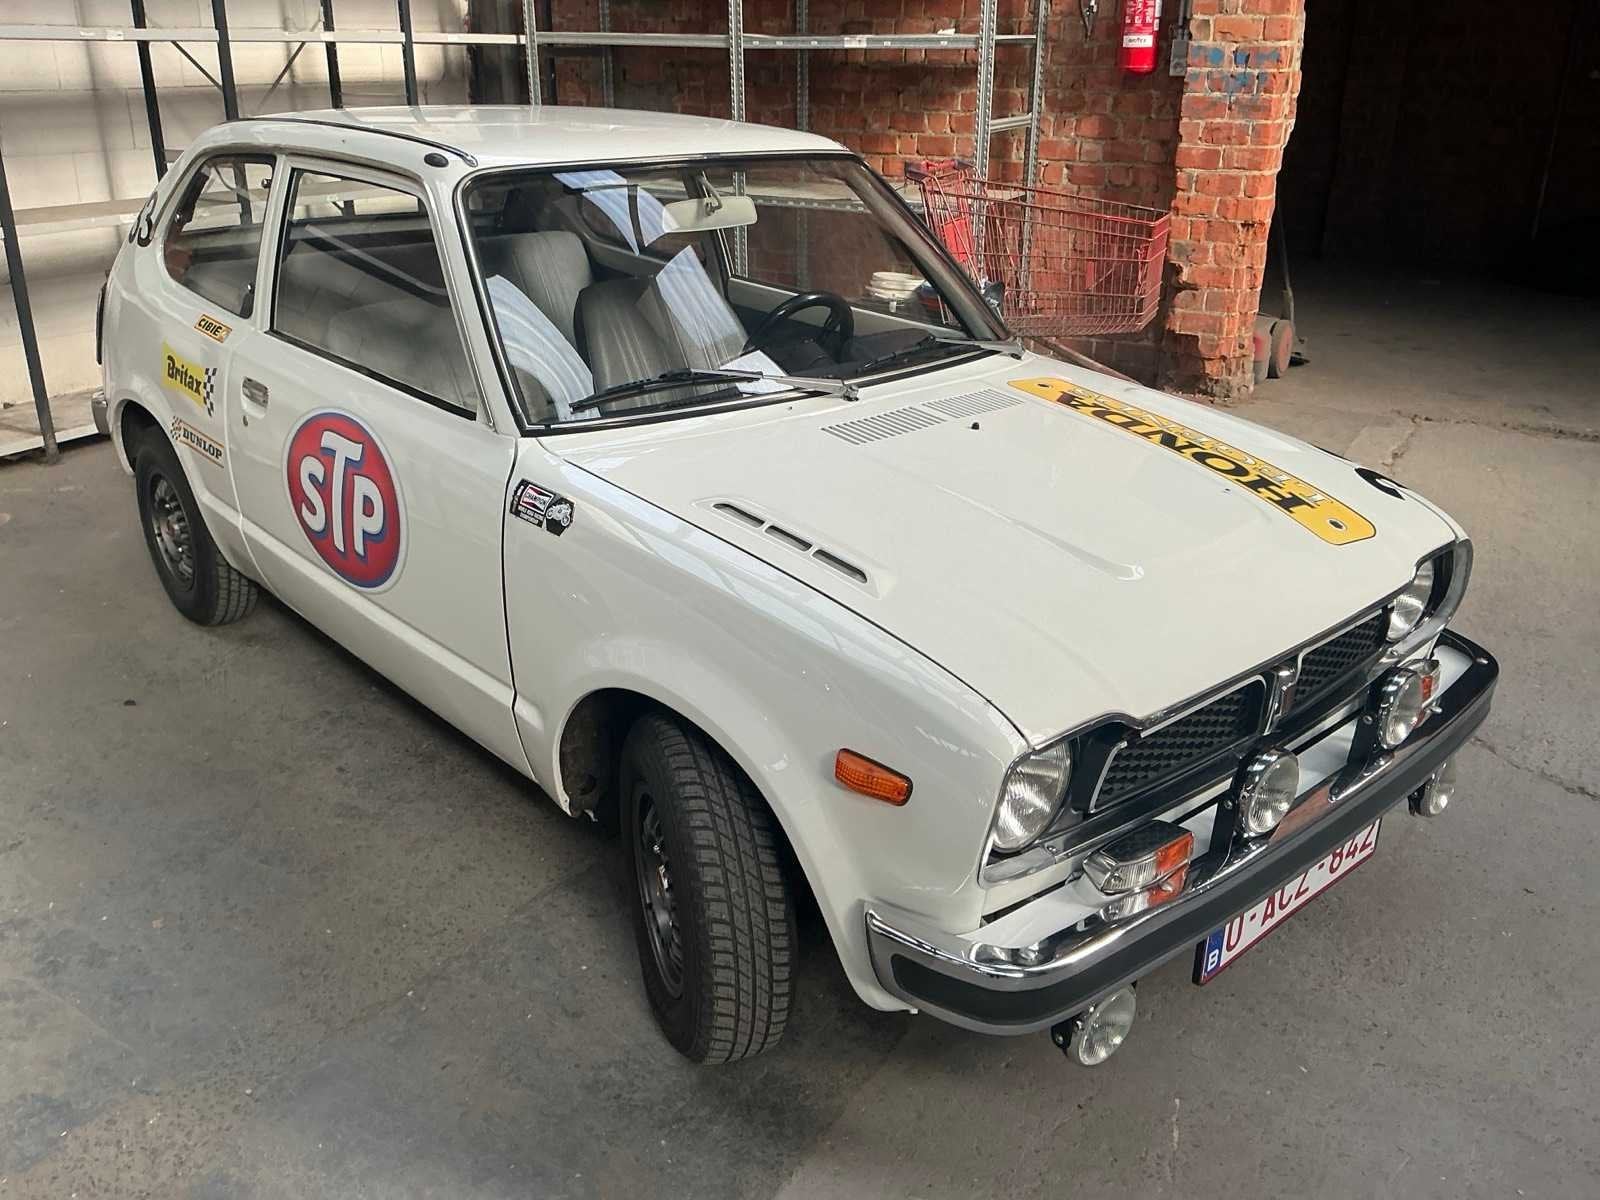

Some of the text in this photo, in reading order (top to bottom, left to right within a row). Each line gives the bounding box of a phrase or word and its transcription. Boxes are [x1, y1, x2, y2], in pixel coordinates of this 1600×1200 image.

[167, 355, 202, 396] Britax
[182, 427, 223, 460] DUNLOP
[1057, 391, 1316, 514] HONDA
[300, 429, 385, 557] STP
[1207, 948, 1220, 972] B
